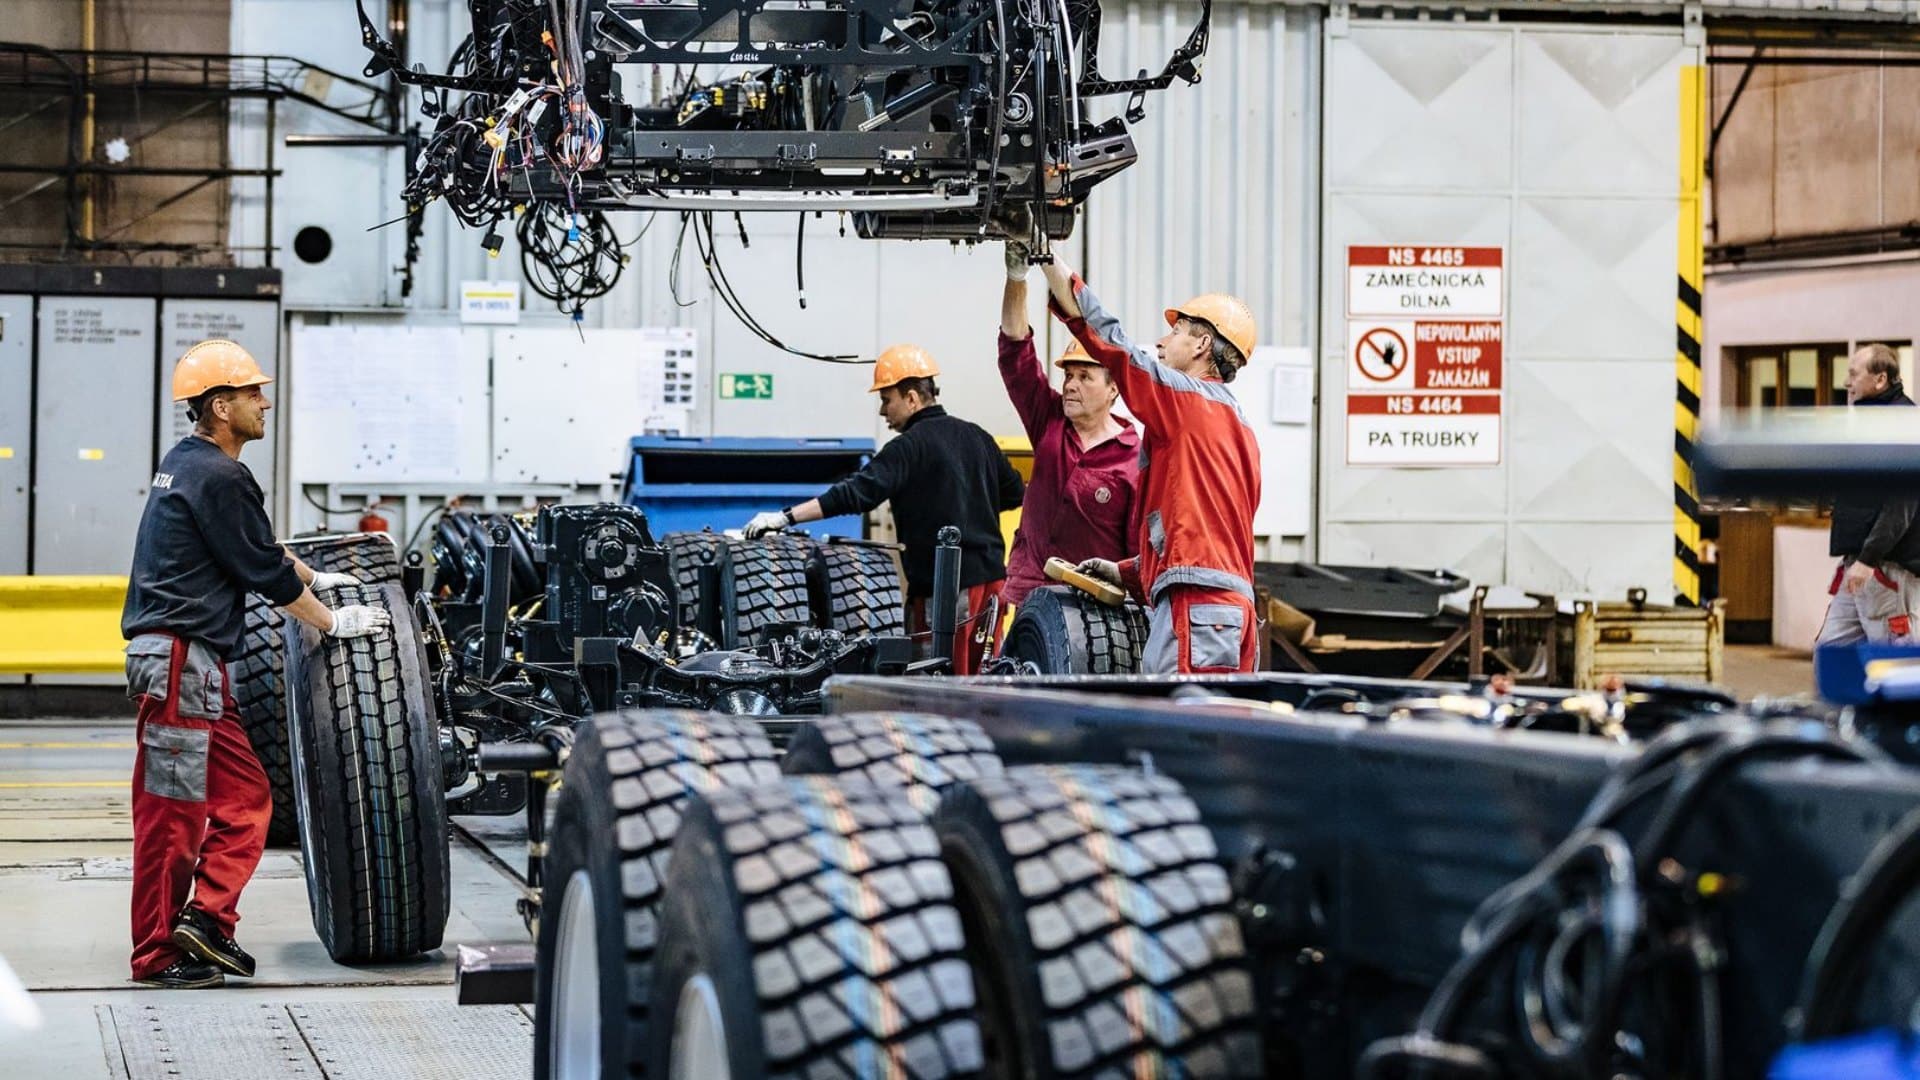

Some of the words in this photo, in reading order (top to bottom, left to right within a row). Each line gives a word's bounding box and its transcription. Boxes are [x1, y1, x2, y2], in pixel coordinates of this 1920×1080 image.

[1388, 249, 1416, 264] NS
[1420, 249, 1464, 265] 4465
[1366, 269, 1485, 288] ZÁMEČNICKÁ
[1401, 293, 1450, 308] DÍLNA
[1416, 323, 1500, 342] NEPOVOLANÝM
[1436, 346, 1482, 365] VSTUP
[1427, 367, 1490, 387] ZAKÁZÁN
[1387, 398, 1413, 413] NS
[1419, 397, 1462, 413] 4464
[1368, 432, 1393, 447] PA
[1400, 432, 1479, 447] TRUBKY
